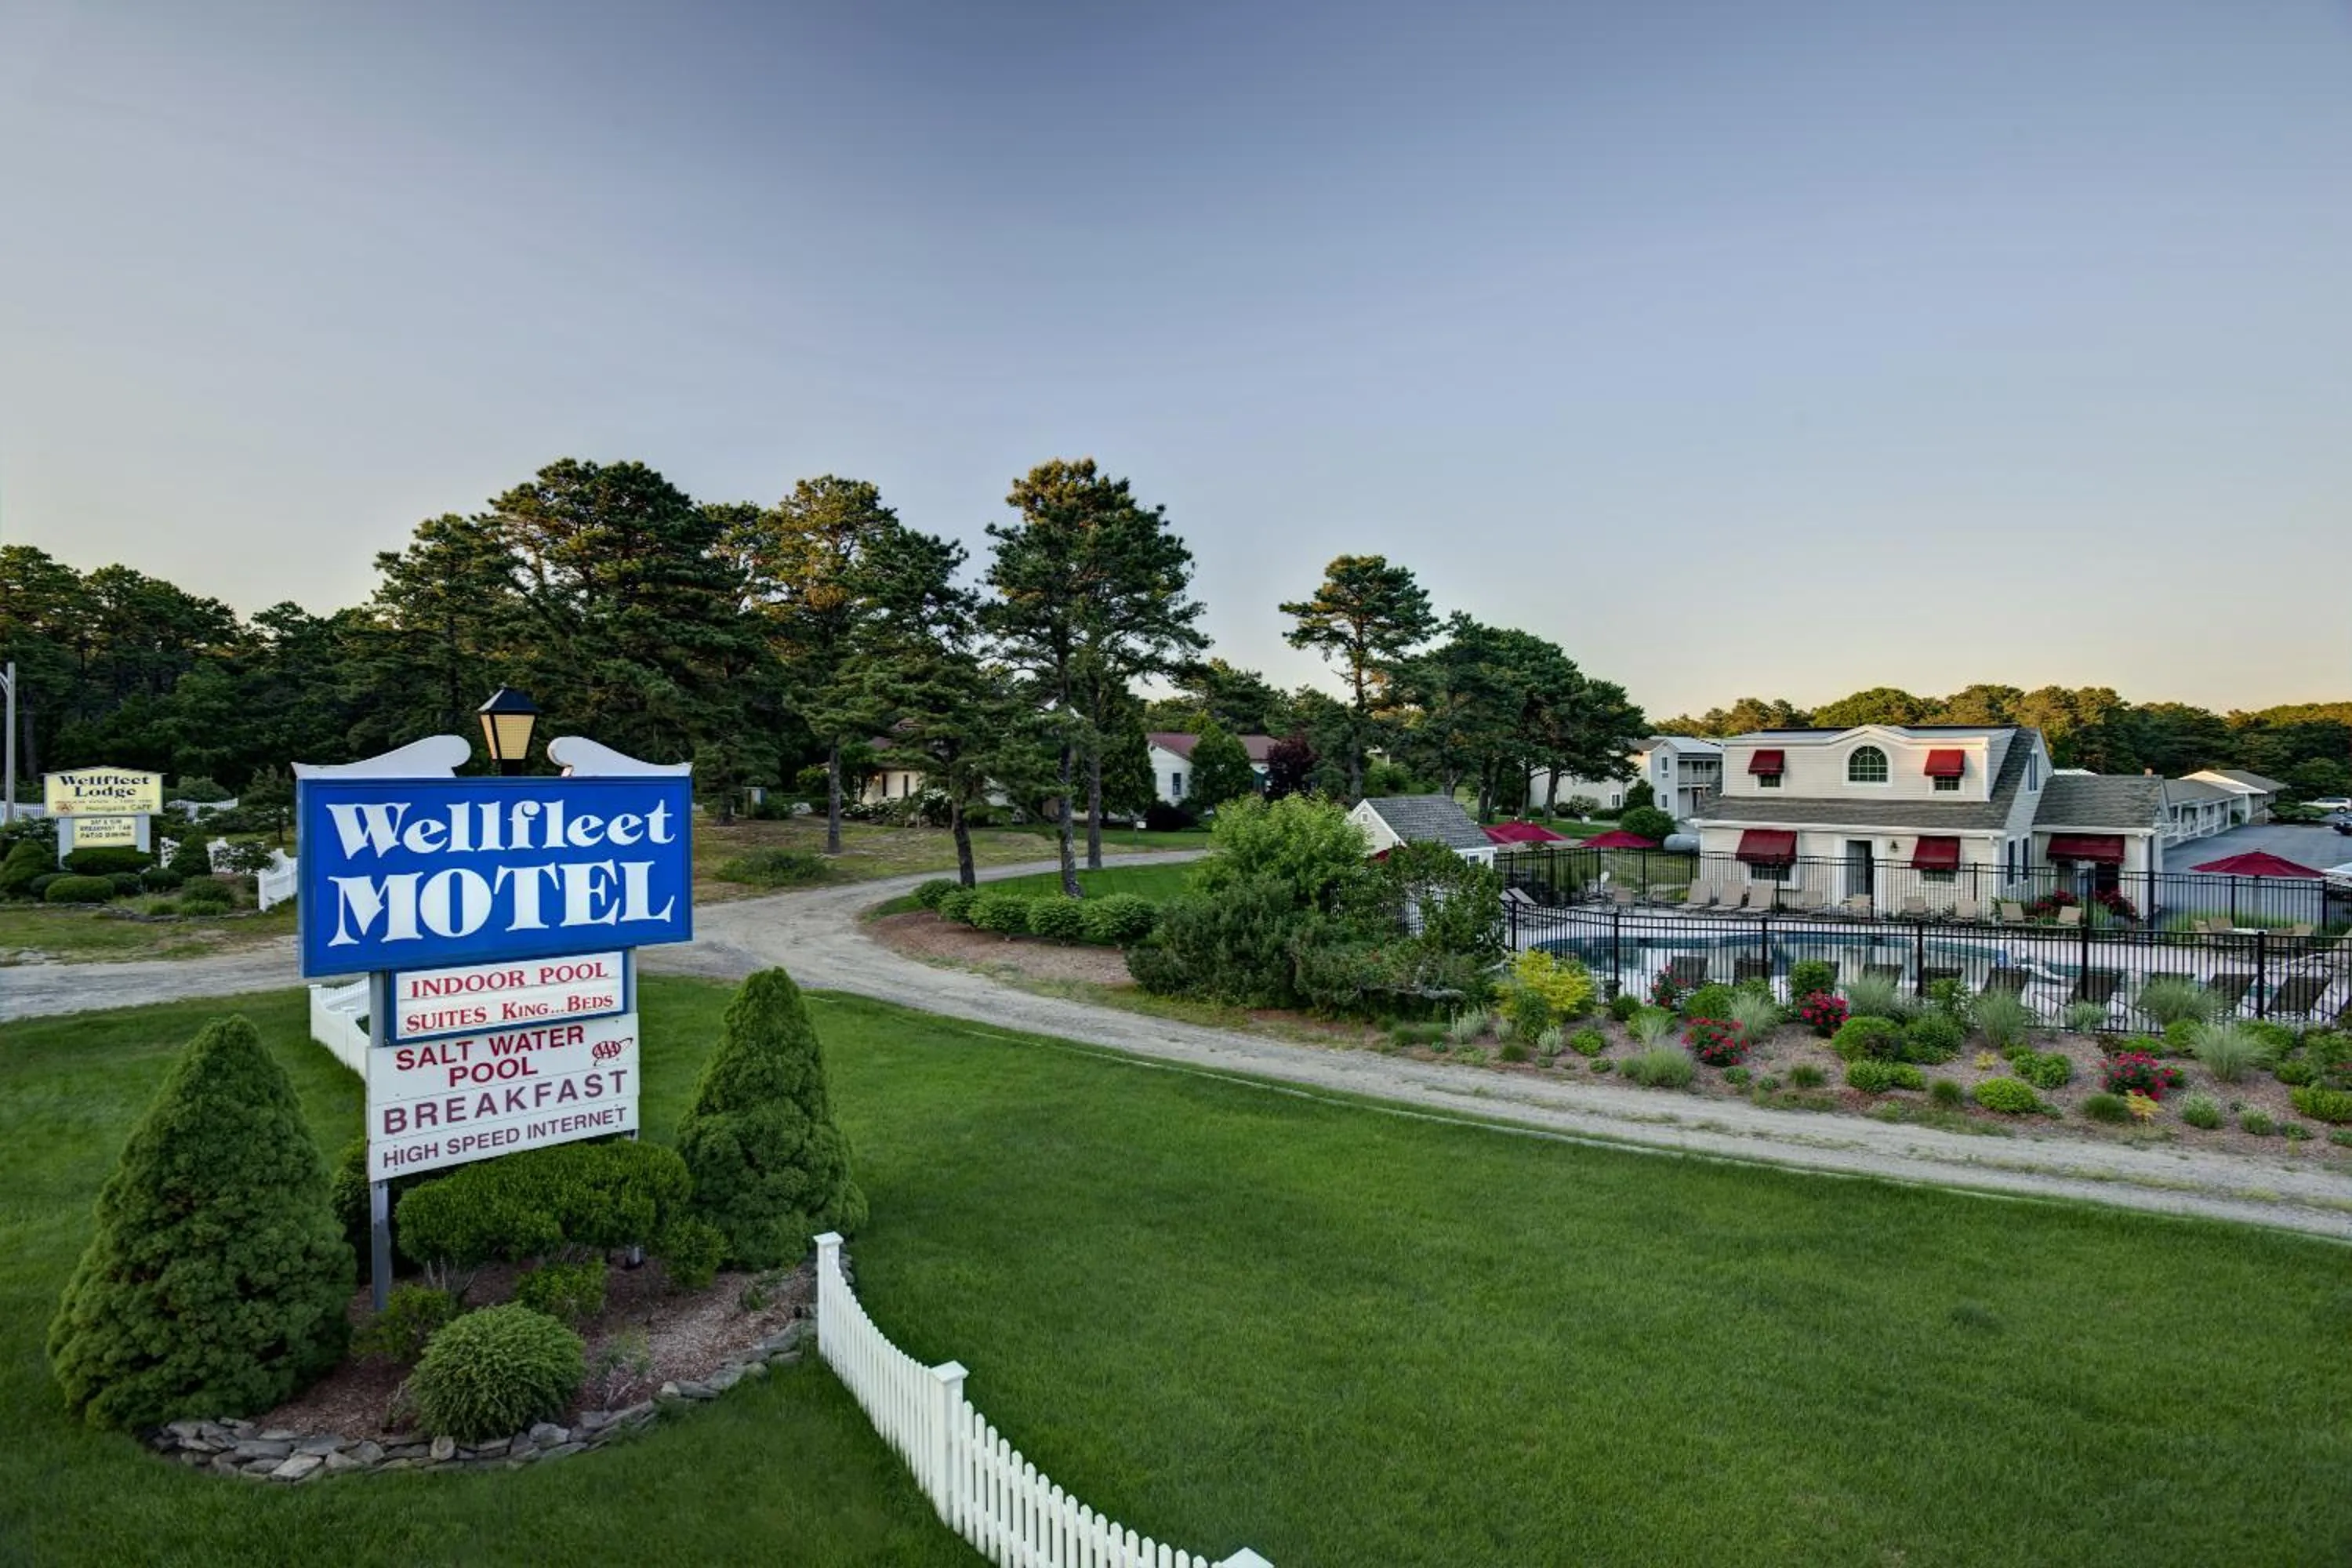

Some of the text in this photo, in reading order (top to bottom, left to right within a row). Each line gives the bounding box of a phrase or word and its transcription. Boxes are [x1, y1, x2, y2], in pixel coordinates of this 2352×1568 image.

[60, 775, 151, 785] Wellfleet
[75, 786, 136, 798] Lodge
[326, 799, 675, 860] Wellfleet
[328, 859, 675, 948] MOTEL
[411, 962, 609, 998] INDOOR POOL
[406, 1007, 487, 1033] SUITES
[396, 1025, 584, 1071] SALT WATER
[449, 1057, 539, 1088] POOL
[383, 1069, 628, 1135] BREAKFAST
[383, 1107, 627, 1169] HIGH SPEED INTERNET
